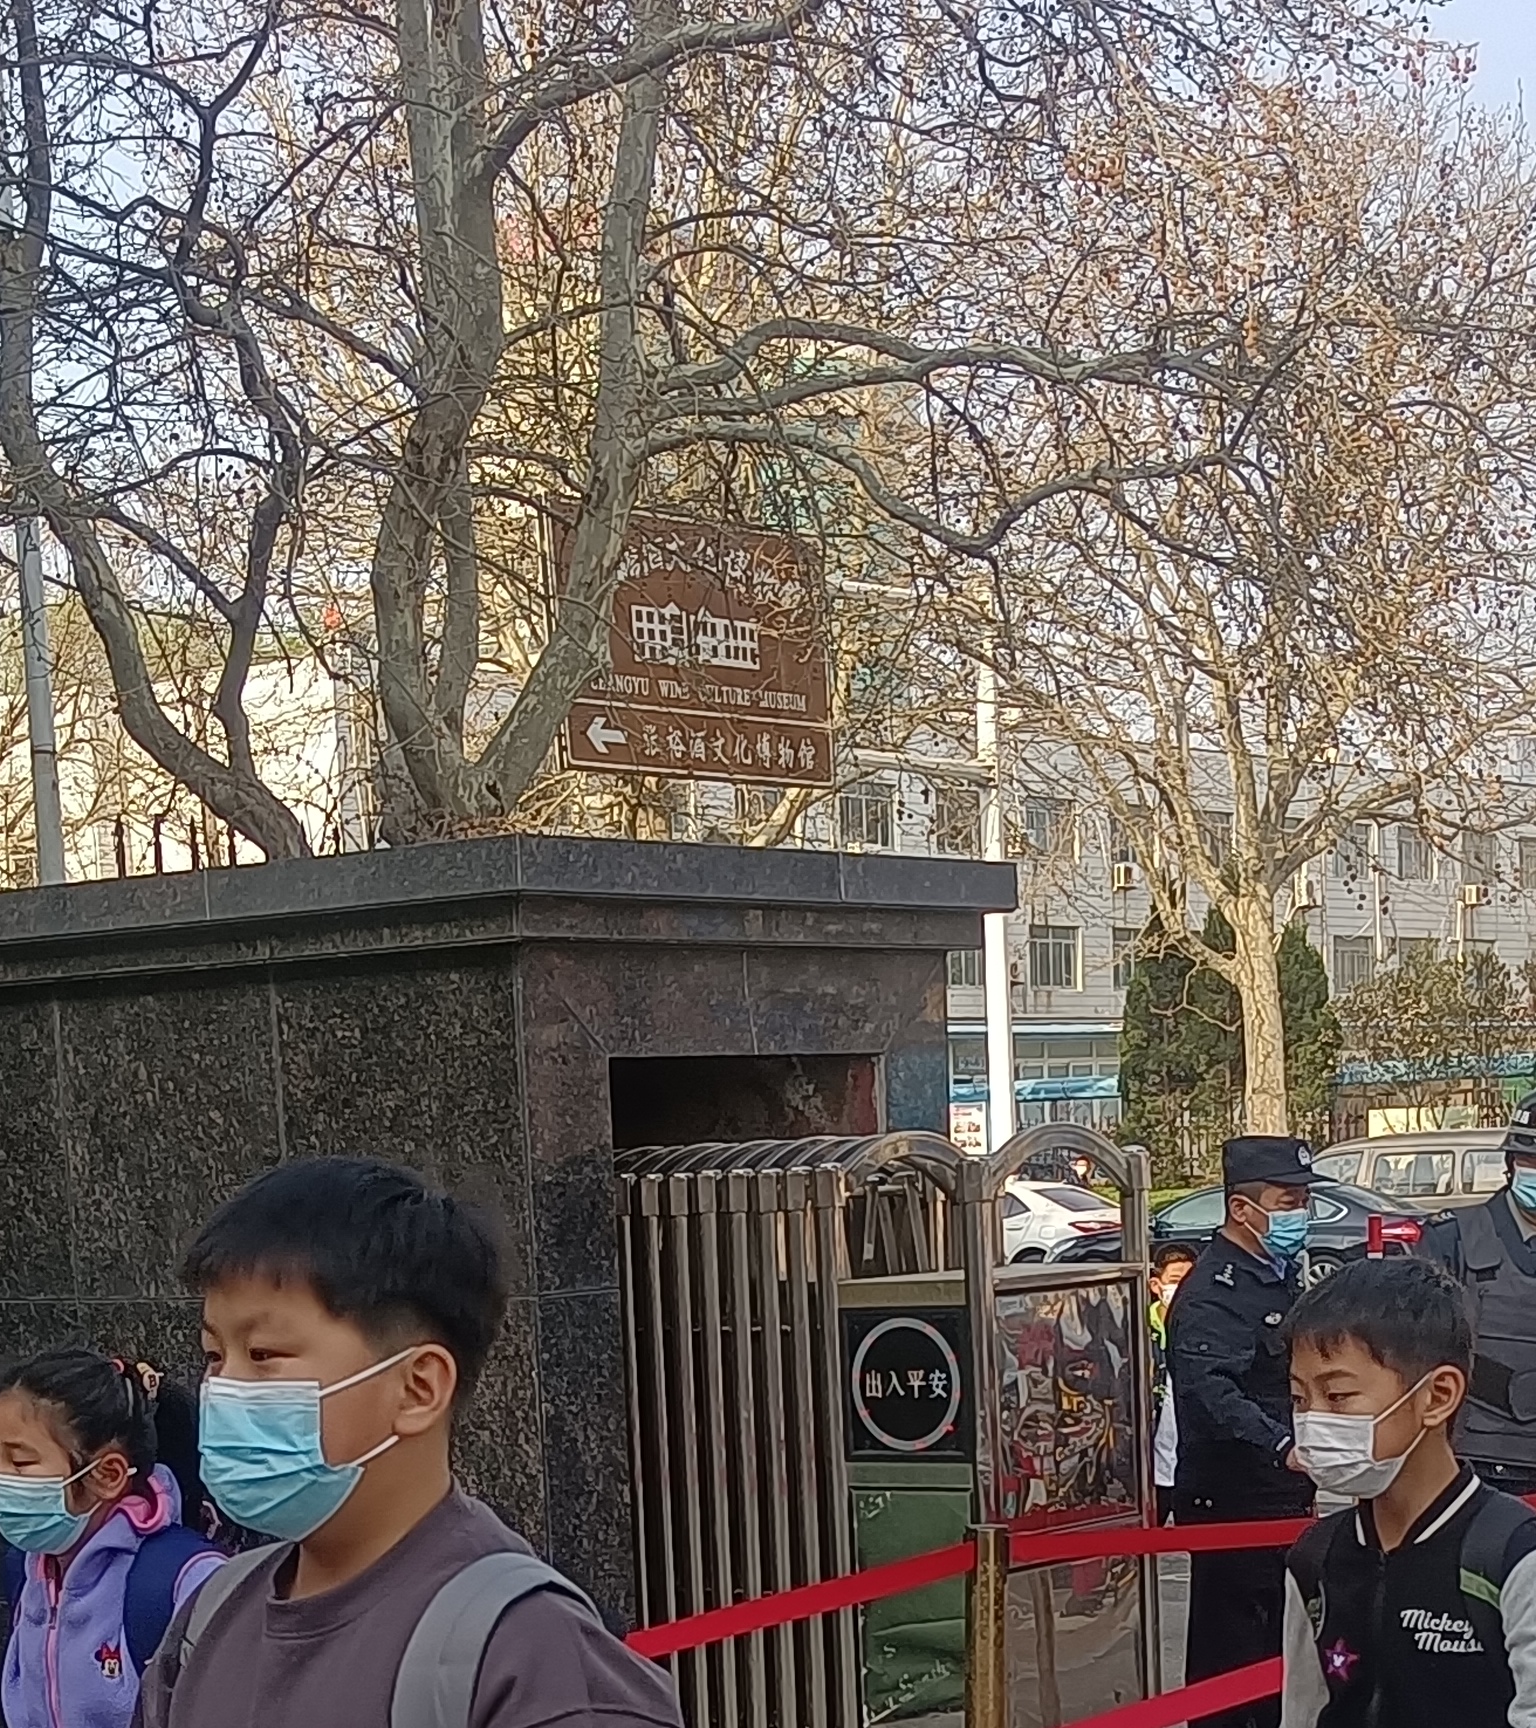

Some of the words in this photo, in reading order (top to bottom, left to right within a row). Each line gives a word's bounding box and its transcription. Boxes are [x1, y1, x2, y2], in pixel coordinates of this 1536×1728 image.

[865, 1368, 948, 1399] 出入平安
[1400, 1608, 1474, 1640] Mickey
